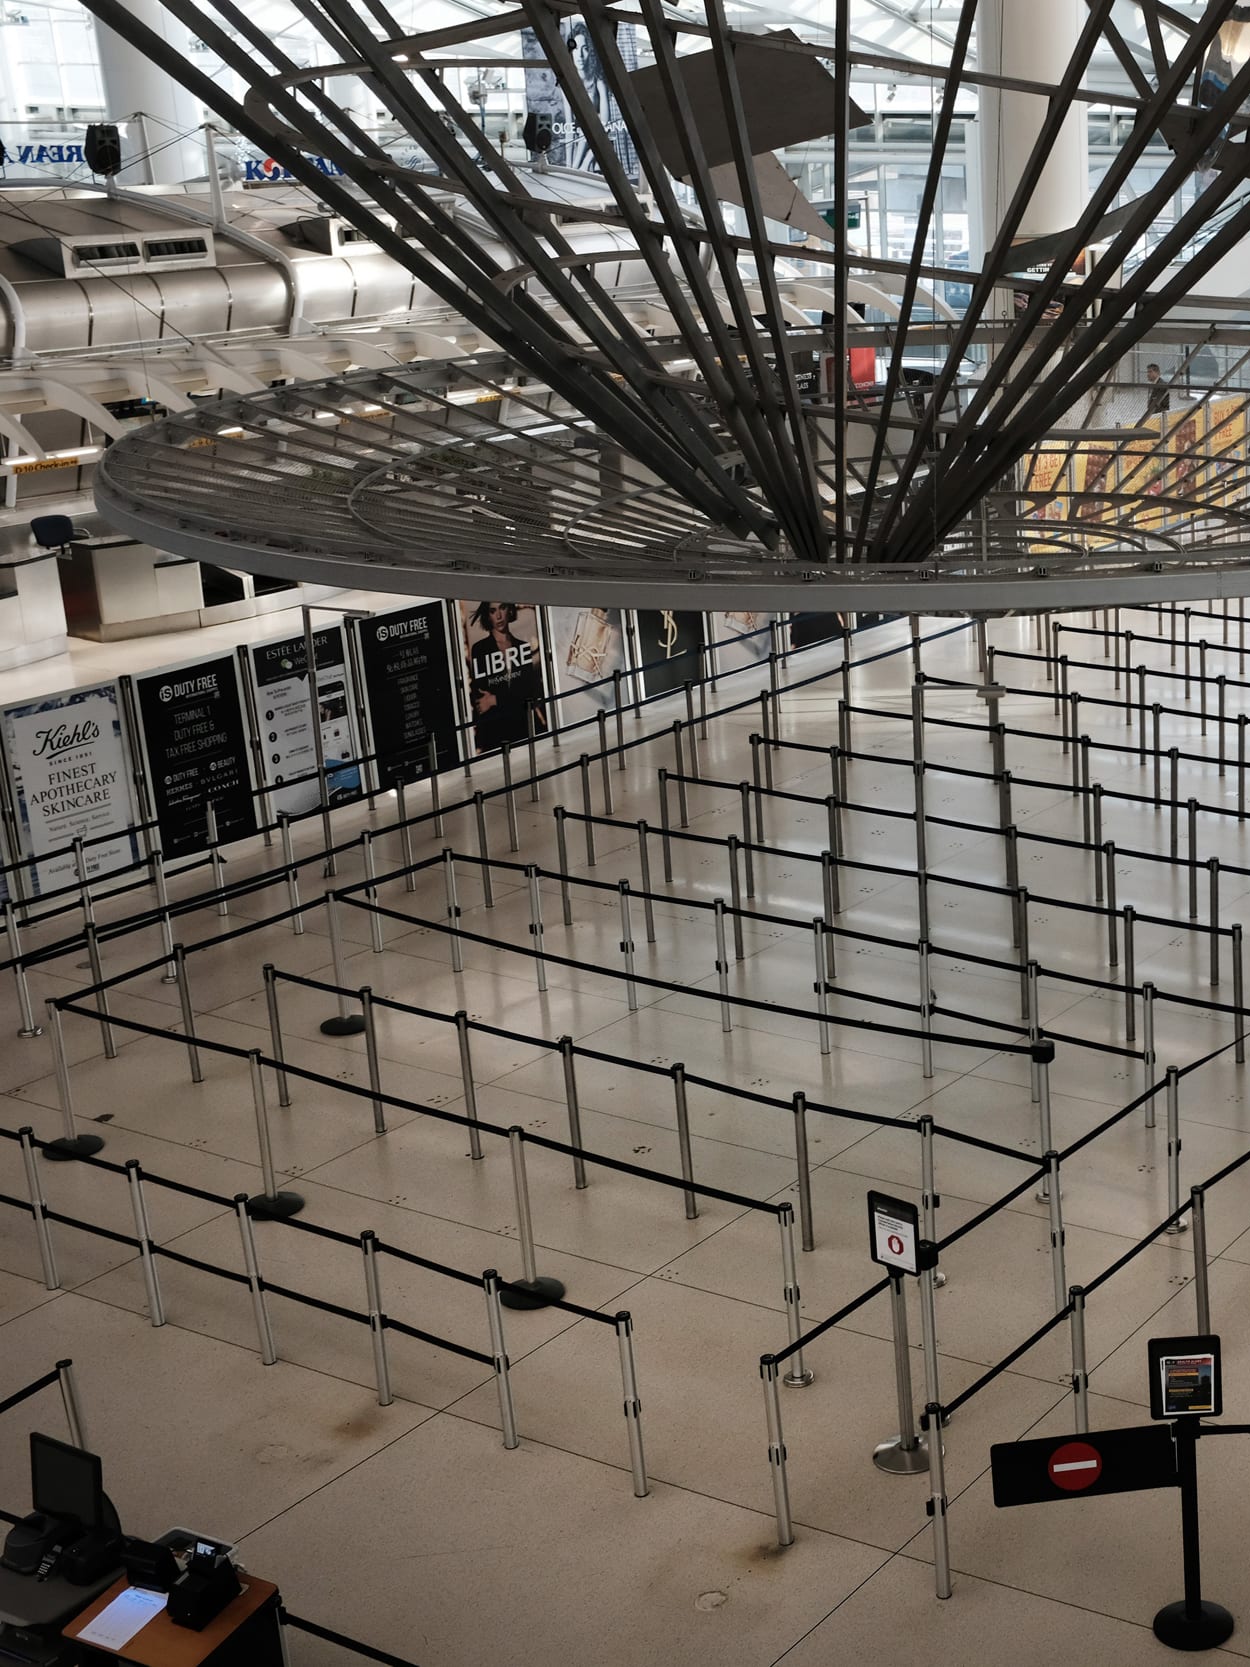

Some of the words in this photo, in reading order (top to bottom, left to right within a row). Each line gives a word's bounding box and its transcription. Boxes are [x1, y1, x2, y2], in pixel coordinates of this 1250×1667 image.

[551, 122, 576, 134] OLCE
[389, 622, 408, 637] DUTY
[409, 617, 428, 632] FREE
[293, 635, 328, 652] LADER
[472, 642, 533, 680] LIBRE
[173, 680, 195, 697] DUTY
[197, 673, 218, 690] FREE
[33, 720, 100, 756] Kiehl's
[173, 727, 191, 741] DUTY
[192, 722, 208, 735] FREE
[180, 741, 197, 754] FREE
[48, 762, 97, 786] FINEST
[30, 770, 117, 806] APOTHECARY
[42, 788, 111, 817] SKINCARE
